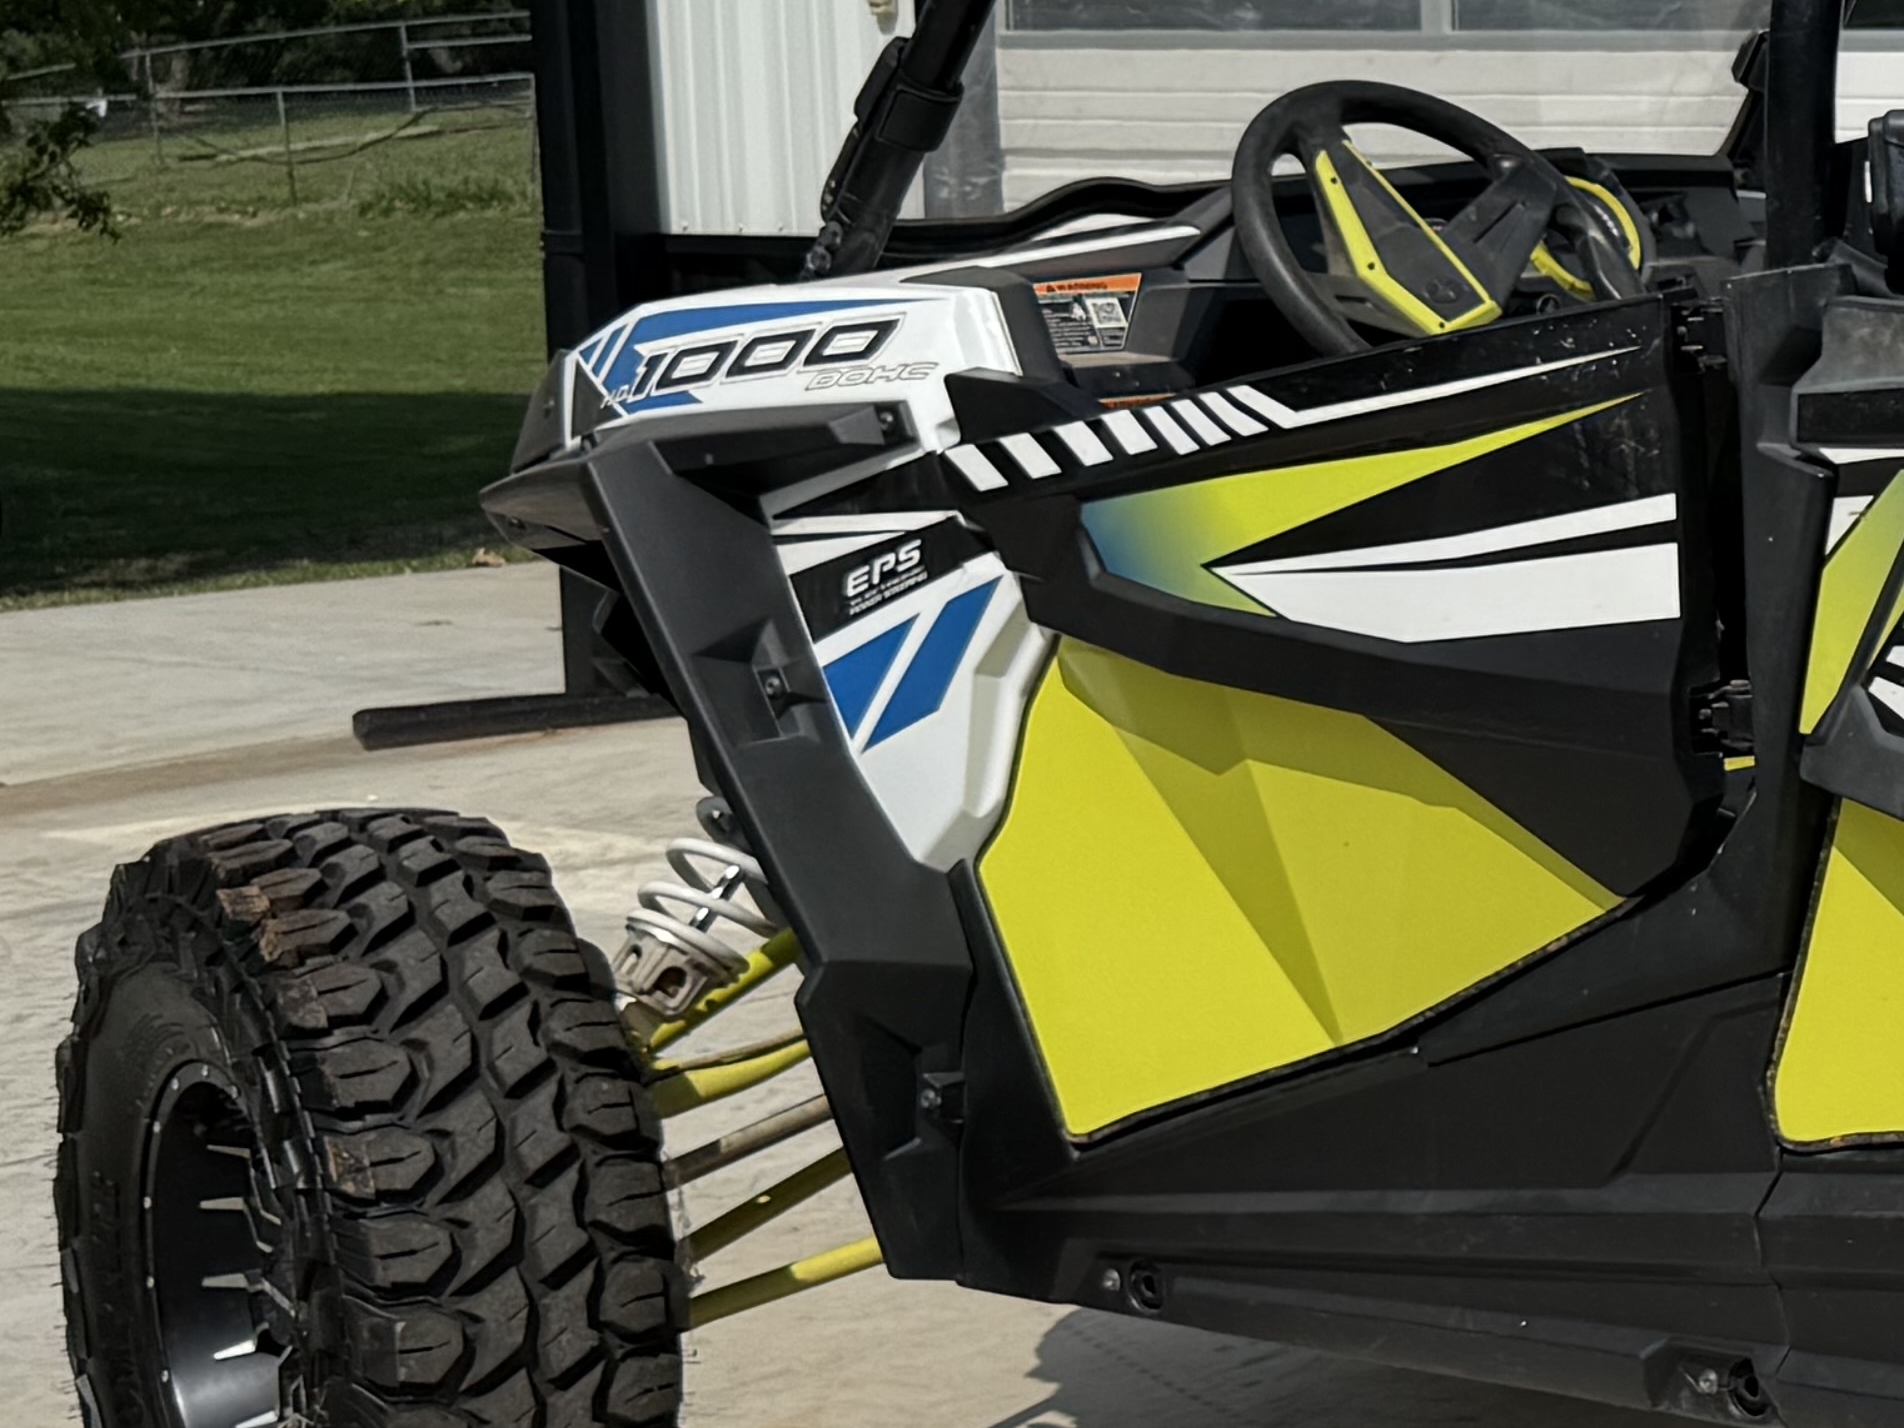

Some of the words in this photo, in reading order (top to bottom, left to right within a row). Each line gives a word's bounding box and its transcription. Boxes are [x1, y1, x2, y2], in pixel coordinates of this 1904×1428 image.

[631, 315, 904, 400] 1000
[806, 362, 939, 391] DOHC
[847, 538, 922, 598] EPS
